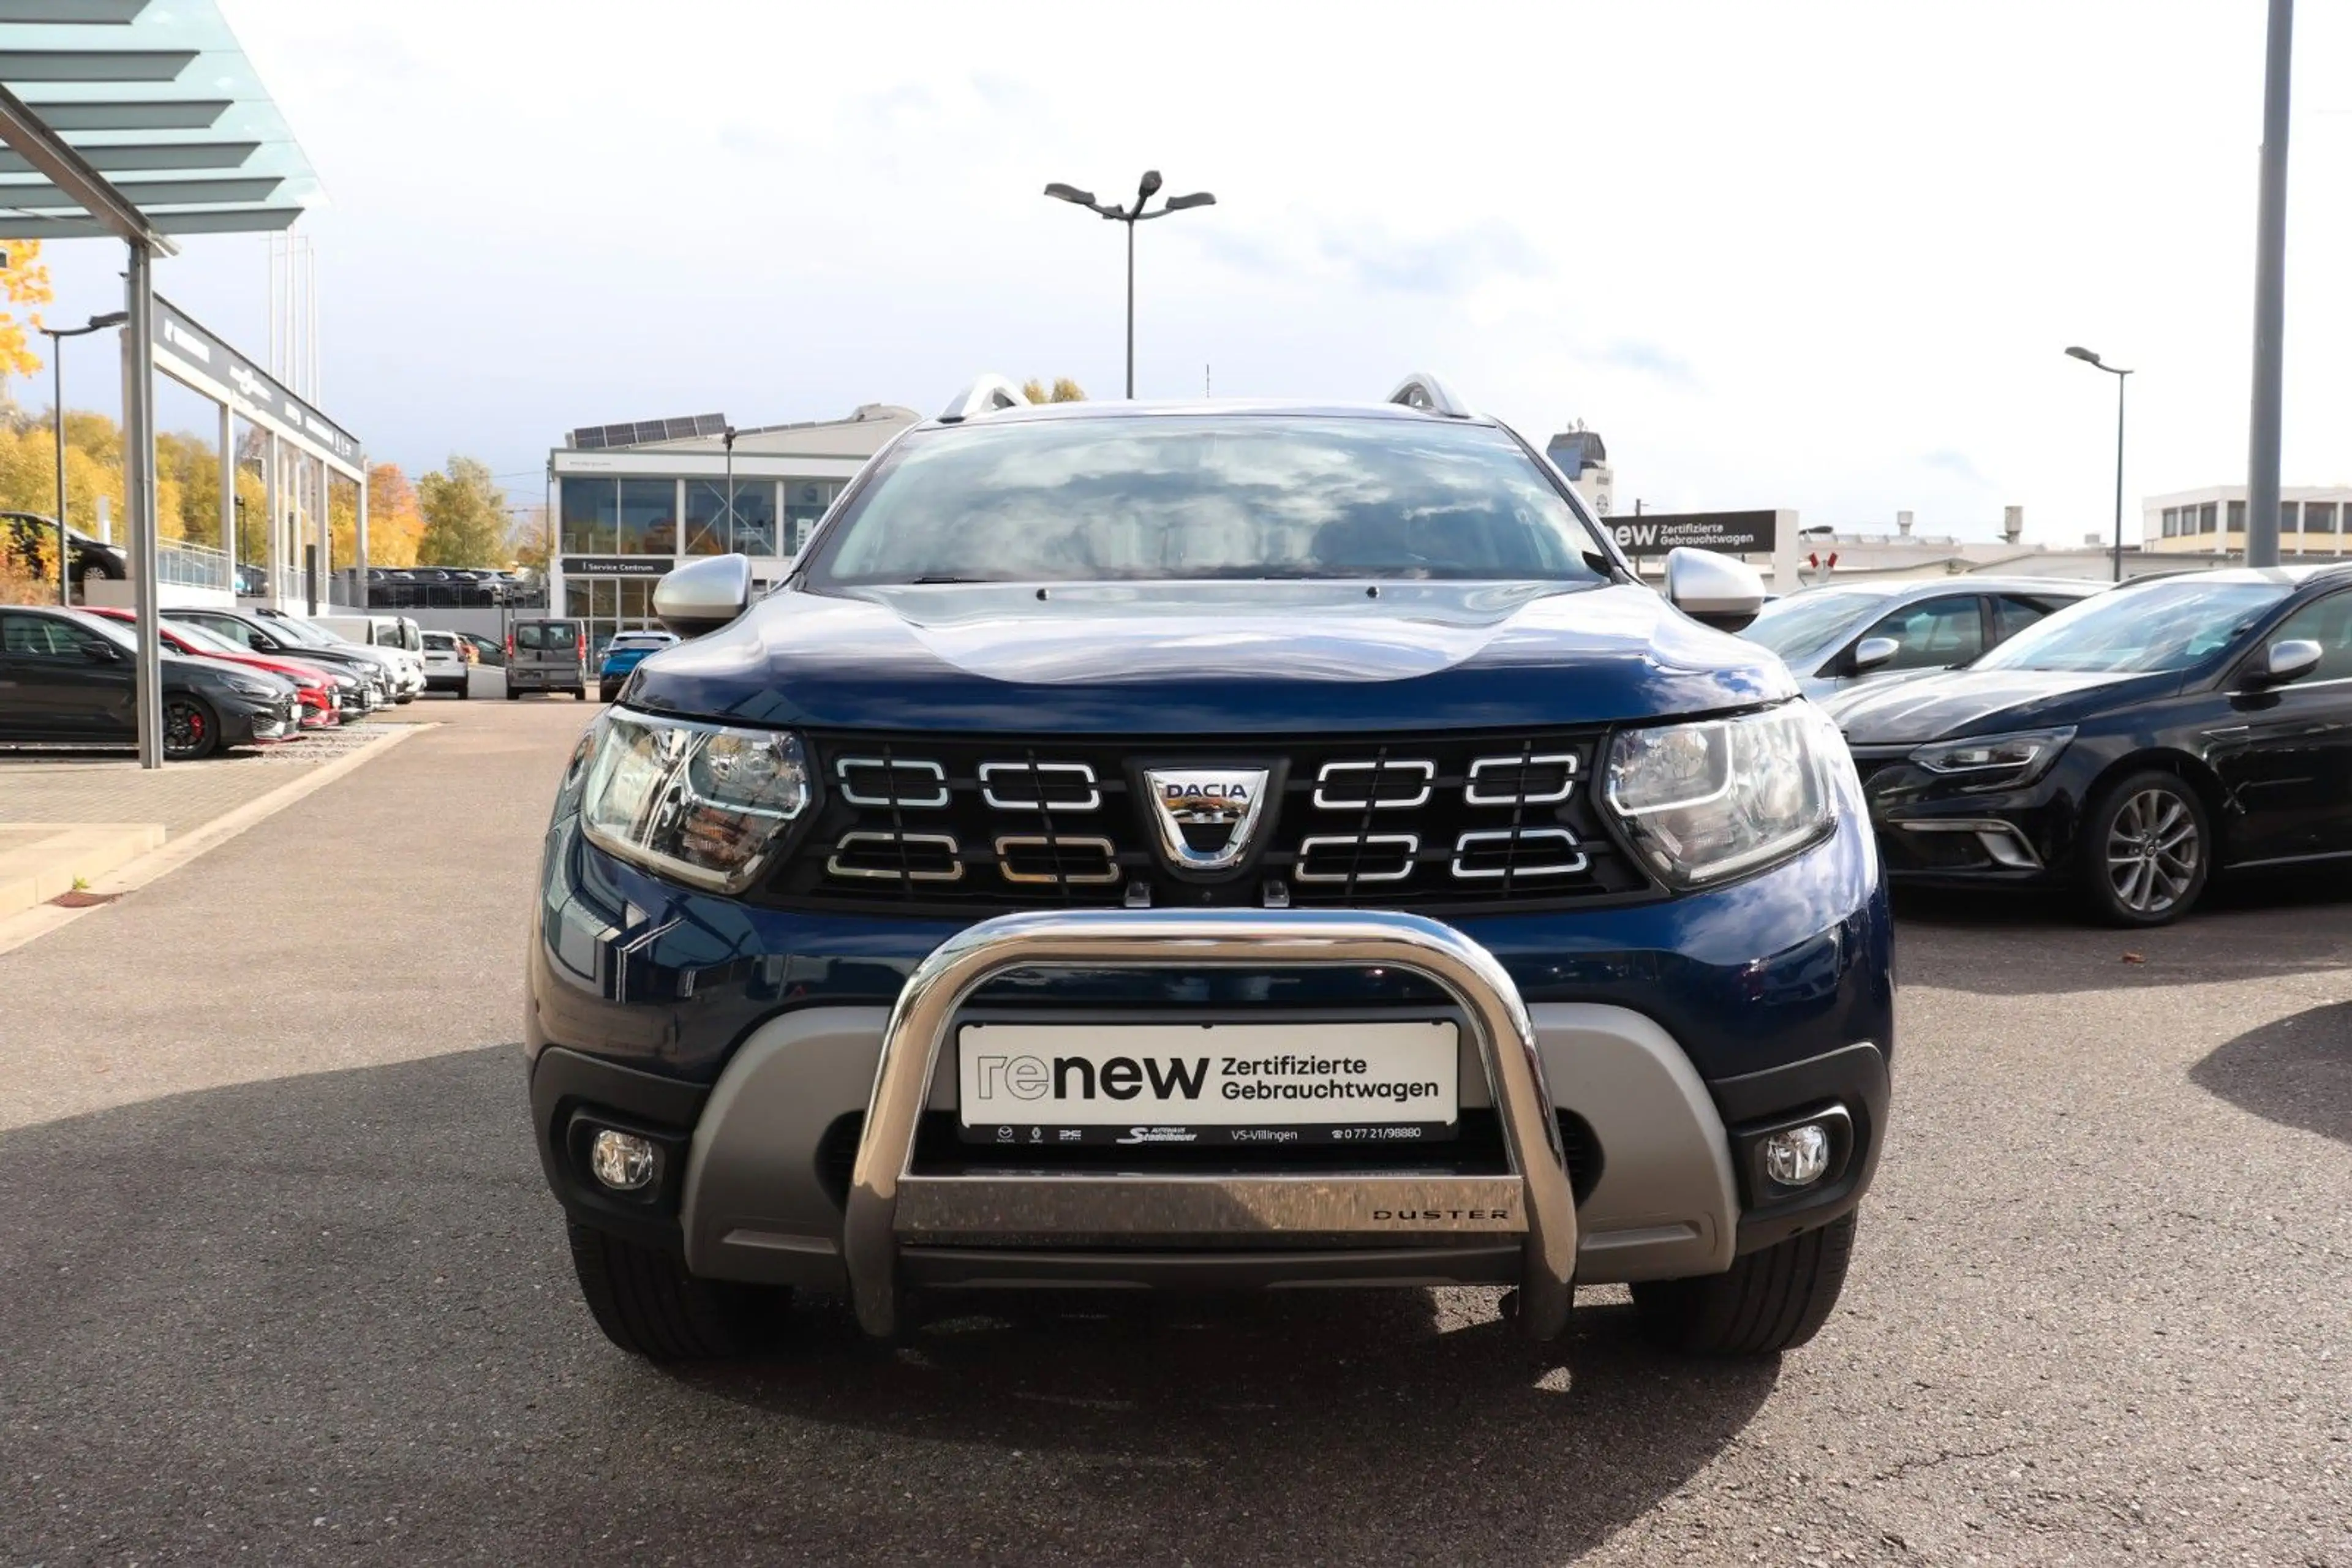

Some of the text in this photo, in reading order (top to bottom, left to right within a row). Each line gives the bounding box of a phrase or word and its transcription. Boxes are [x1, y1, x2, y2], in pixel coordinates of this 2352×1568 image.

[1661, 523, 1724, 534] Zertifizierte
[1660, 533, 1754, 546] Gebrauchtwagen
[1167, 784, 1248, 798] DACIA
[1221, 1055, 1367, 1076] Zertifizierte
[978, 1055, 1210, 1101] renew
[1221, 1079, 1439, 1102] Gebrauchtwagen
[1231, 1130, 1298, 1143] VS-Villingen
[1373, 1210, 1508, 1220] DUSTER
